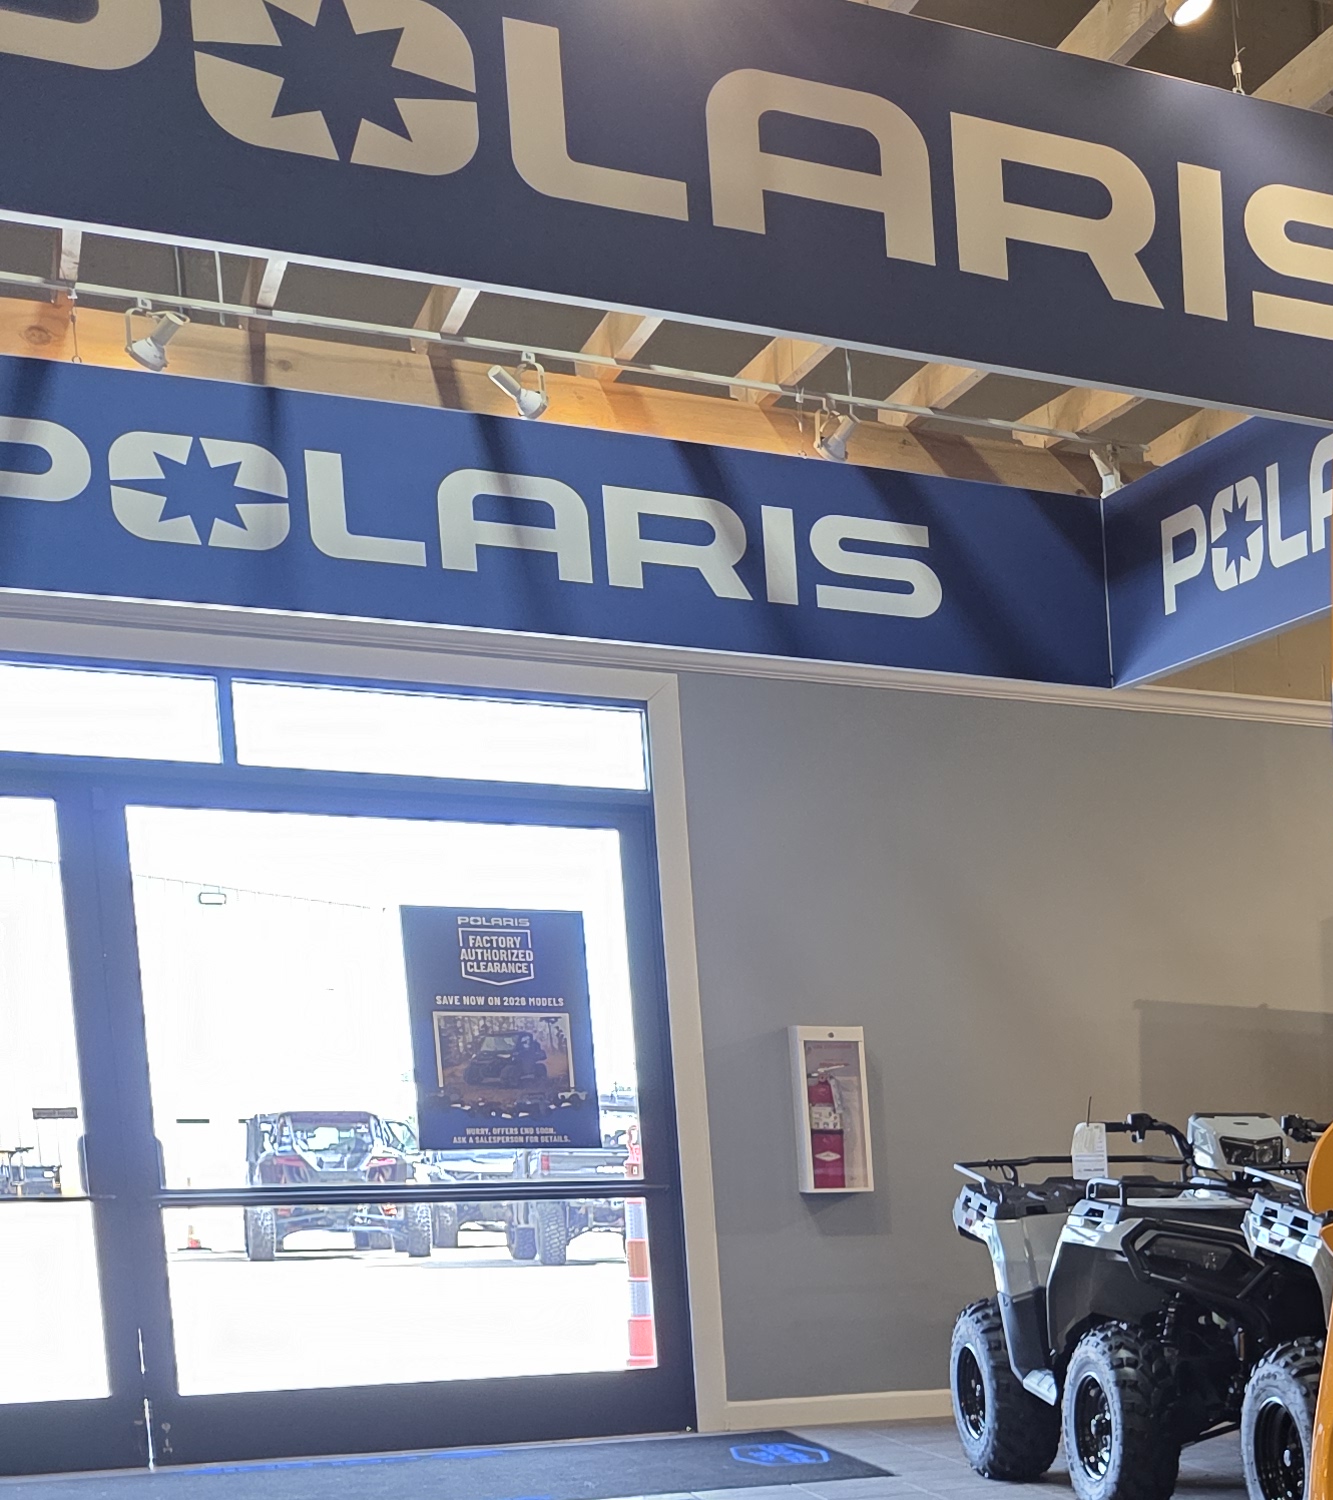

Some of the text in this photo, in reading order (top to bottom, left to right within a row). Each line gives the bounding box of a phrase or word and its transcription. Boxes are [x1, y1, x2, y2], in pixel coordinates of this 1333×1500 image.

[457, 916, 531, 927] POLARIS
[468, 935, 522, 948] FACTORY
[460, 949, 534, 962] AUTHORIZED
[466, 962, 529, 974] CLEARANCE
[435, 996, 461, 1006] SAVE
[462, 996, 485, 1006] NOW
[487, 997, 501, 1006] ON
[528, 997, 564, 1007] MODELS
[465, 1127, 491, 1136] HURRY,
[492, 1127, 519, 1135] OFFERS
[519, 1127, 535, 1135] END
[452, 1136, 467, 1144] ASK
[468, 1136, 474, 1144] A
[475, 1136, 524, 1144] SALESPERSON
[540, 1135, 571, 1143] DETAILS.
